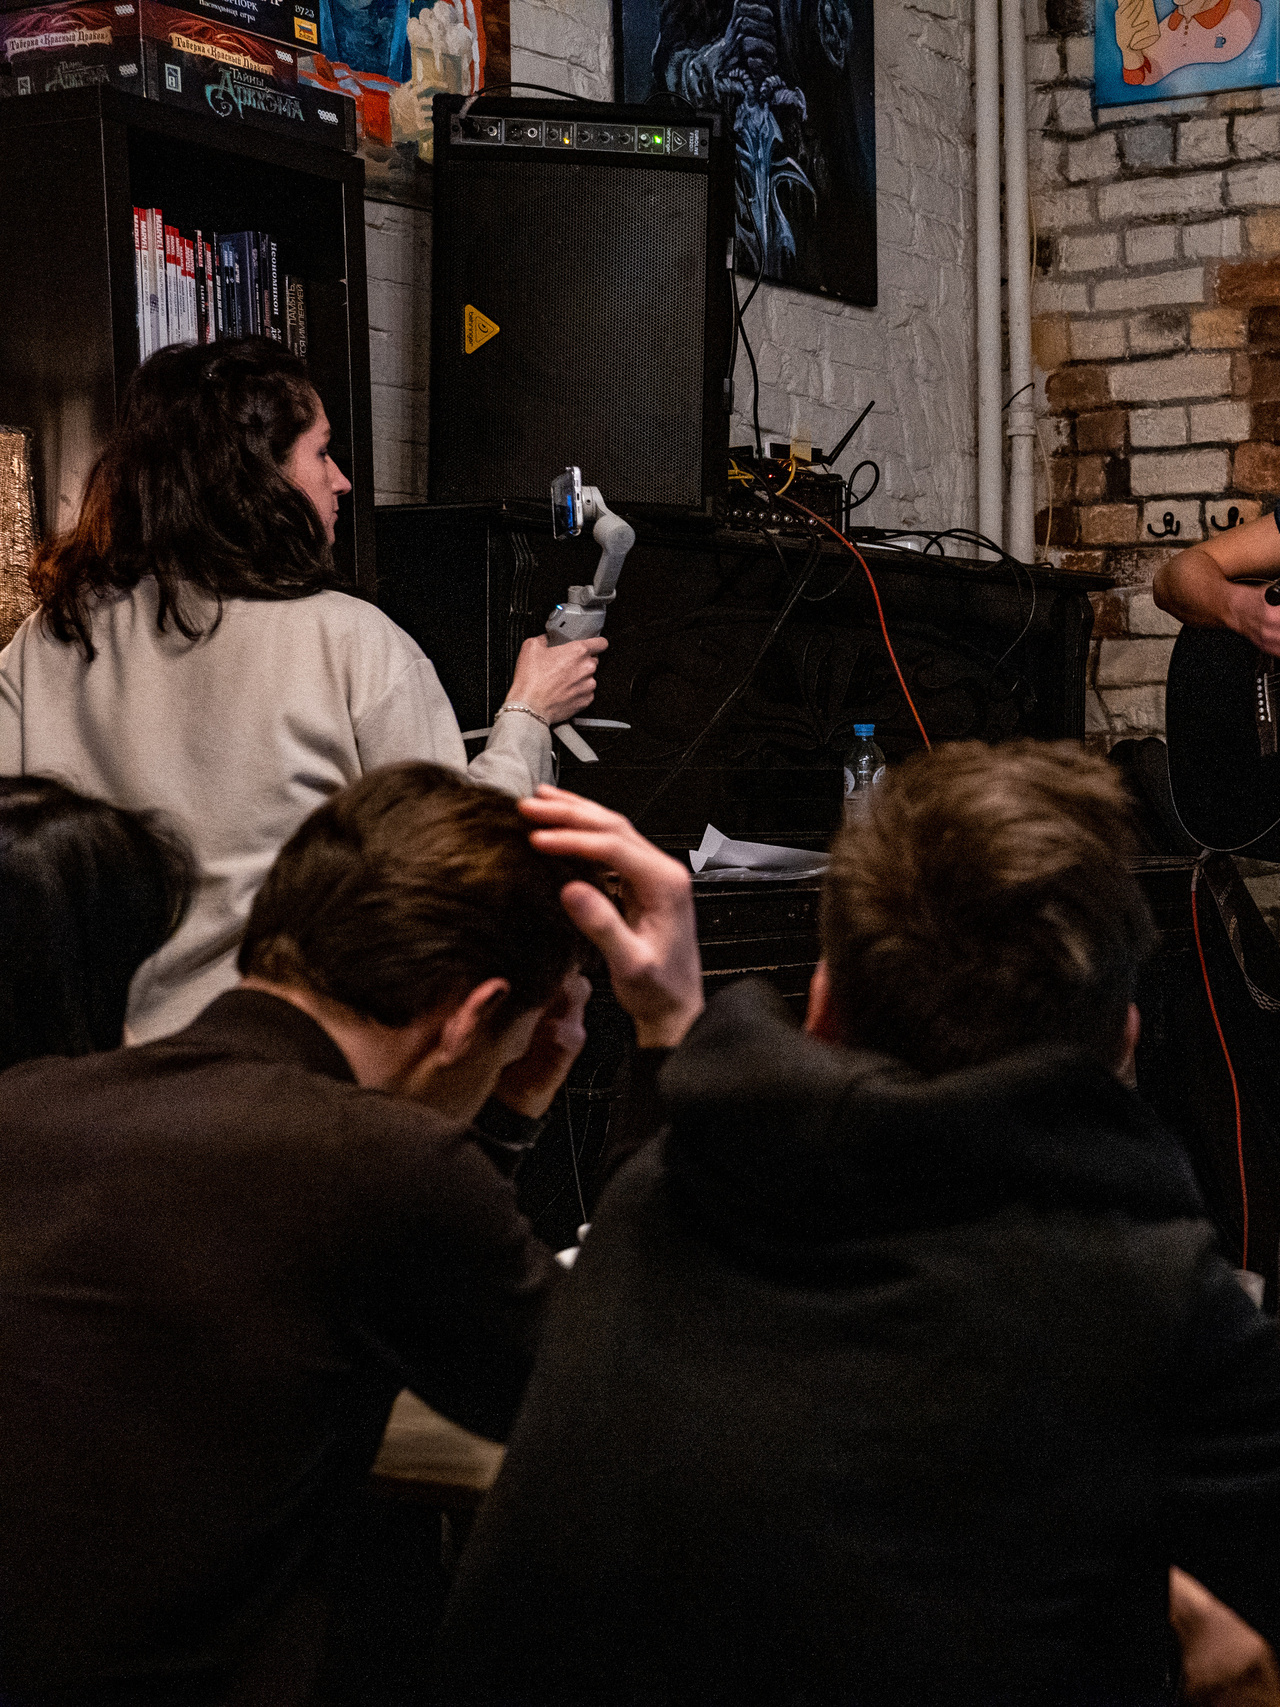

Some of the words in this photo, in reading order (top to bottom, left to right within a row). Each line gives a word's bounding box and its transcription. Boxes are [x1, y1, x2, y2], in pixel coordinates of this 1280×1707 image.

[294, 4, 315, 19] 8723
[175, 37, 206, 53] Таверна
[270, 242, 279, 315] Неономикон
[296, 284, 306, 339] ИМПЕРИЕЙ
